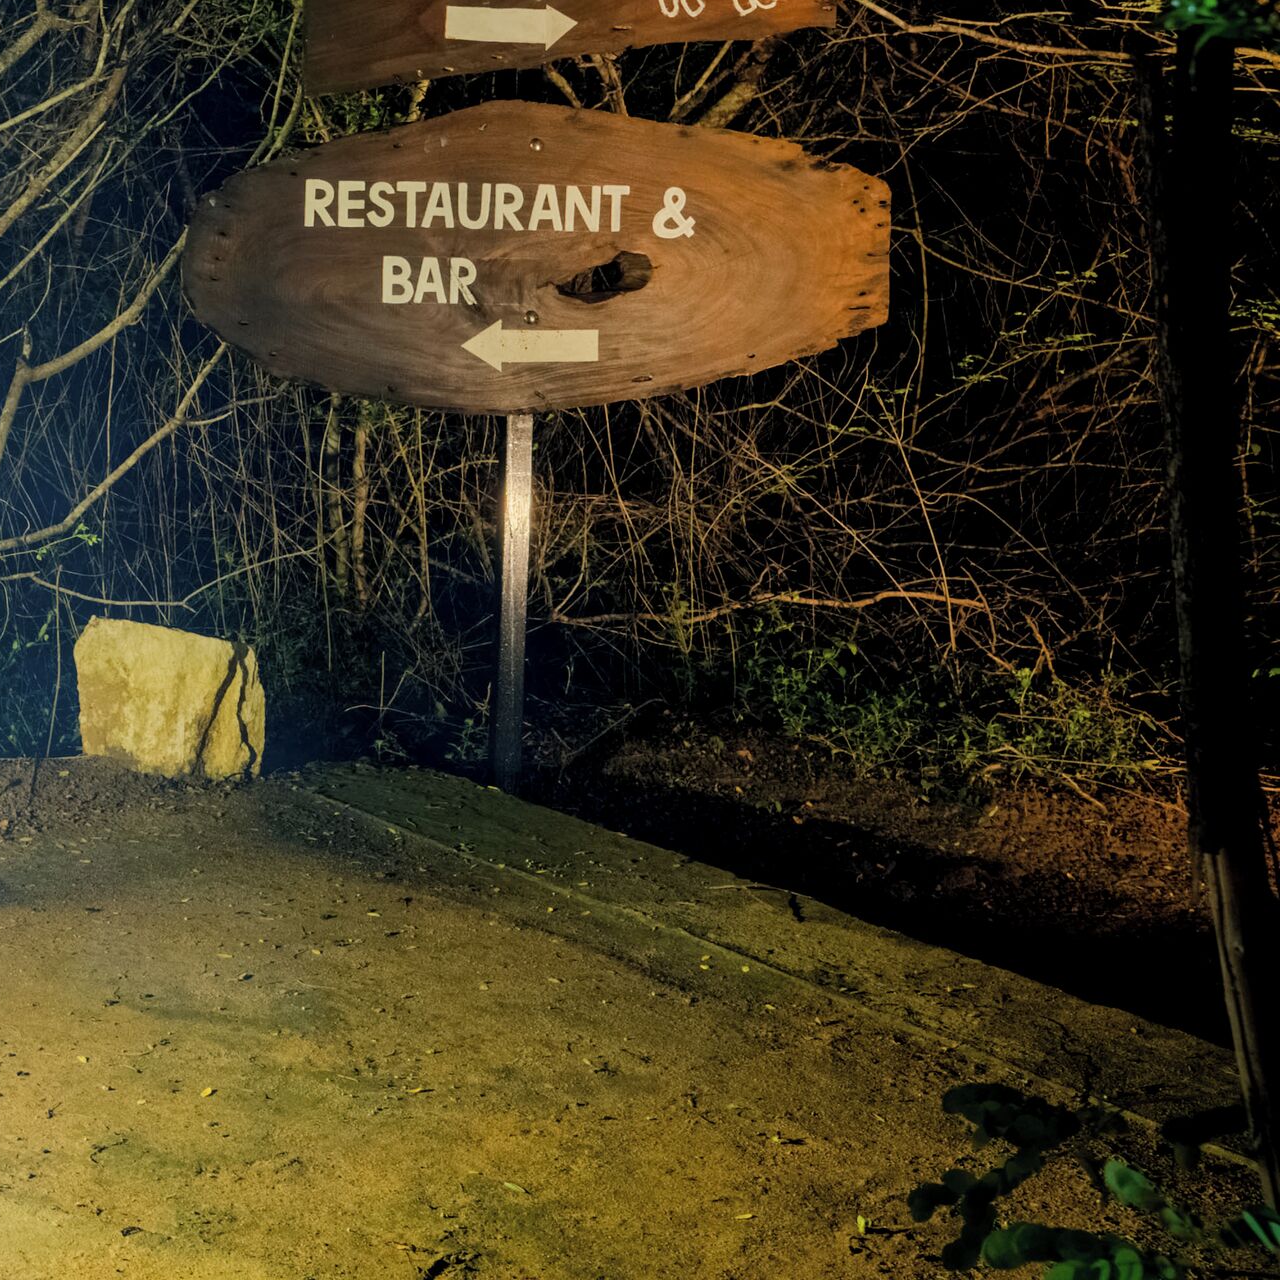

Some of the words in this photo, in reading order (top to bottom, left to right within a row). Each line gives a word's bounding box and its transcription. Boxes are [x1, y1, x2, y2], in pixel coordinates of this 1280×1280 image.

[304, 178, 630, 232] RESTAURANT
[653, 187, 696, 239] &
[381, 255, 478, 305] BAR
